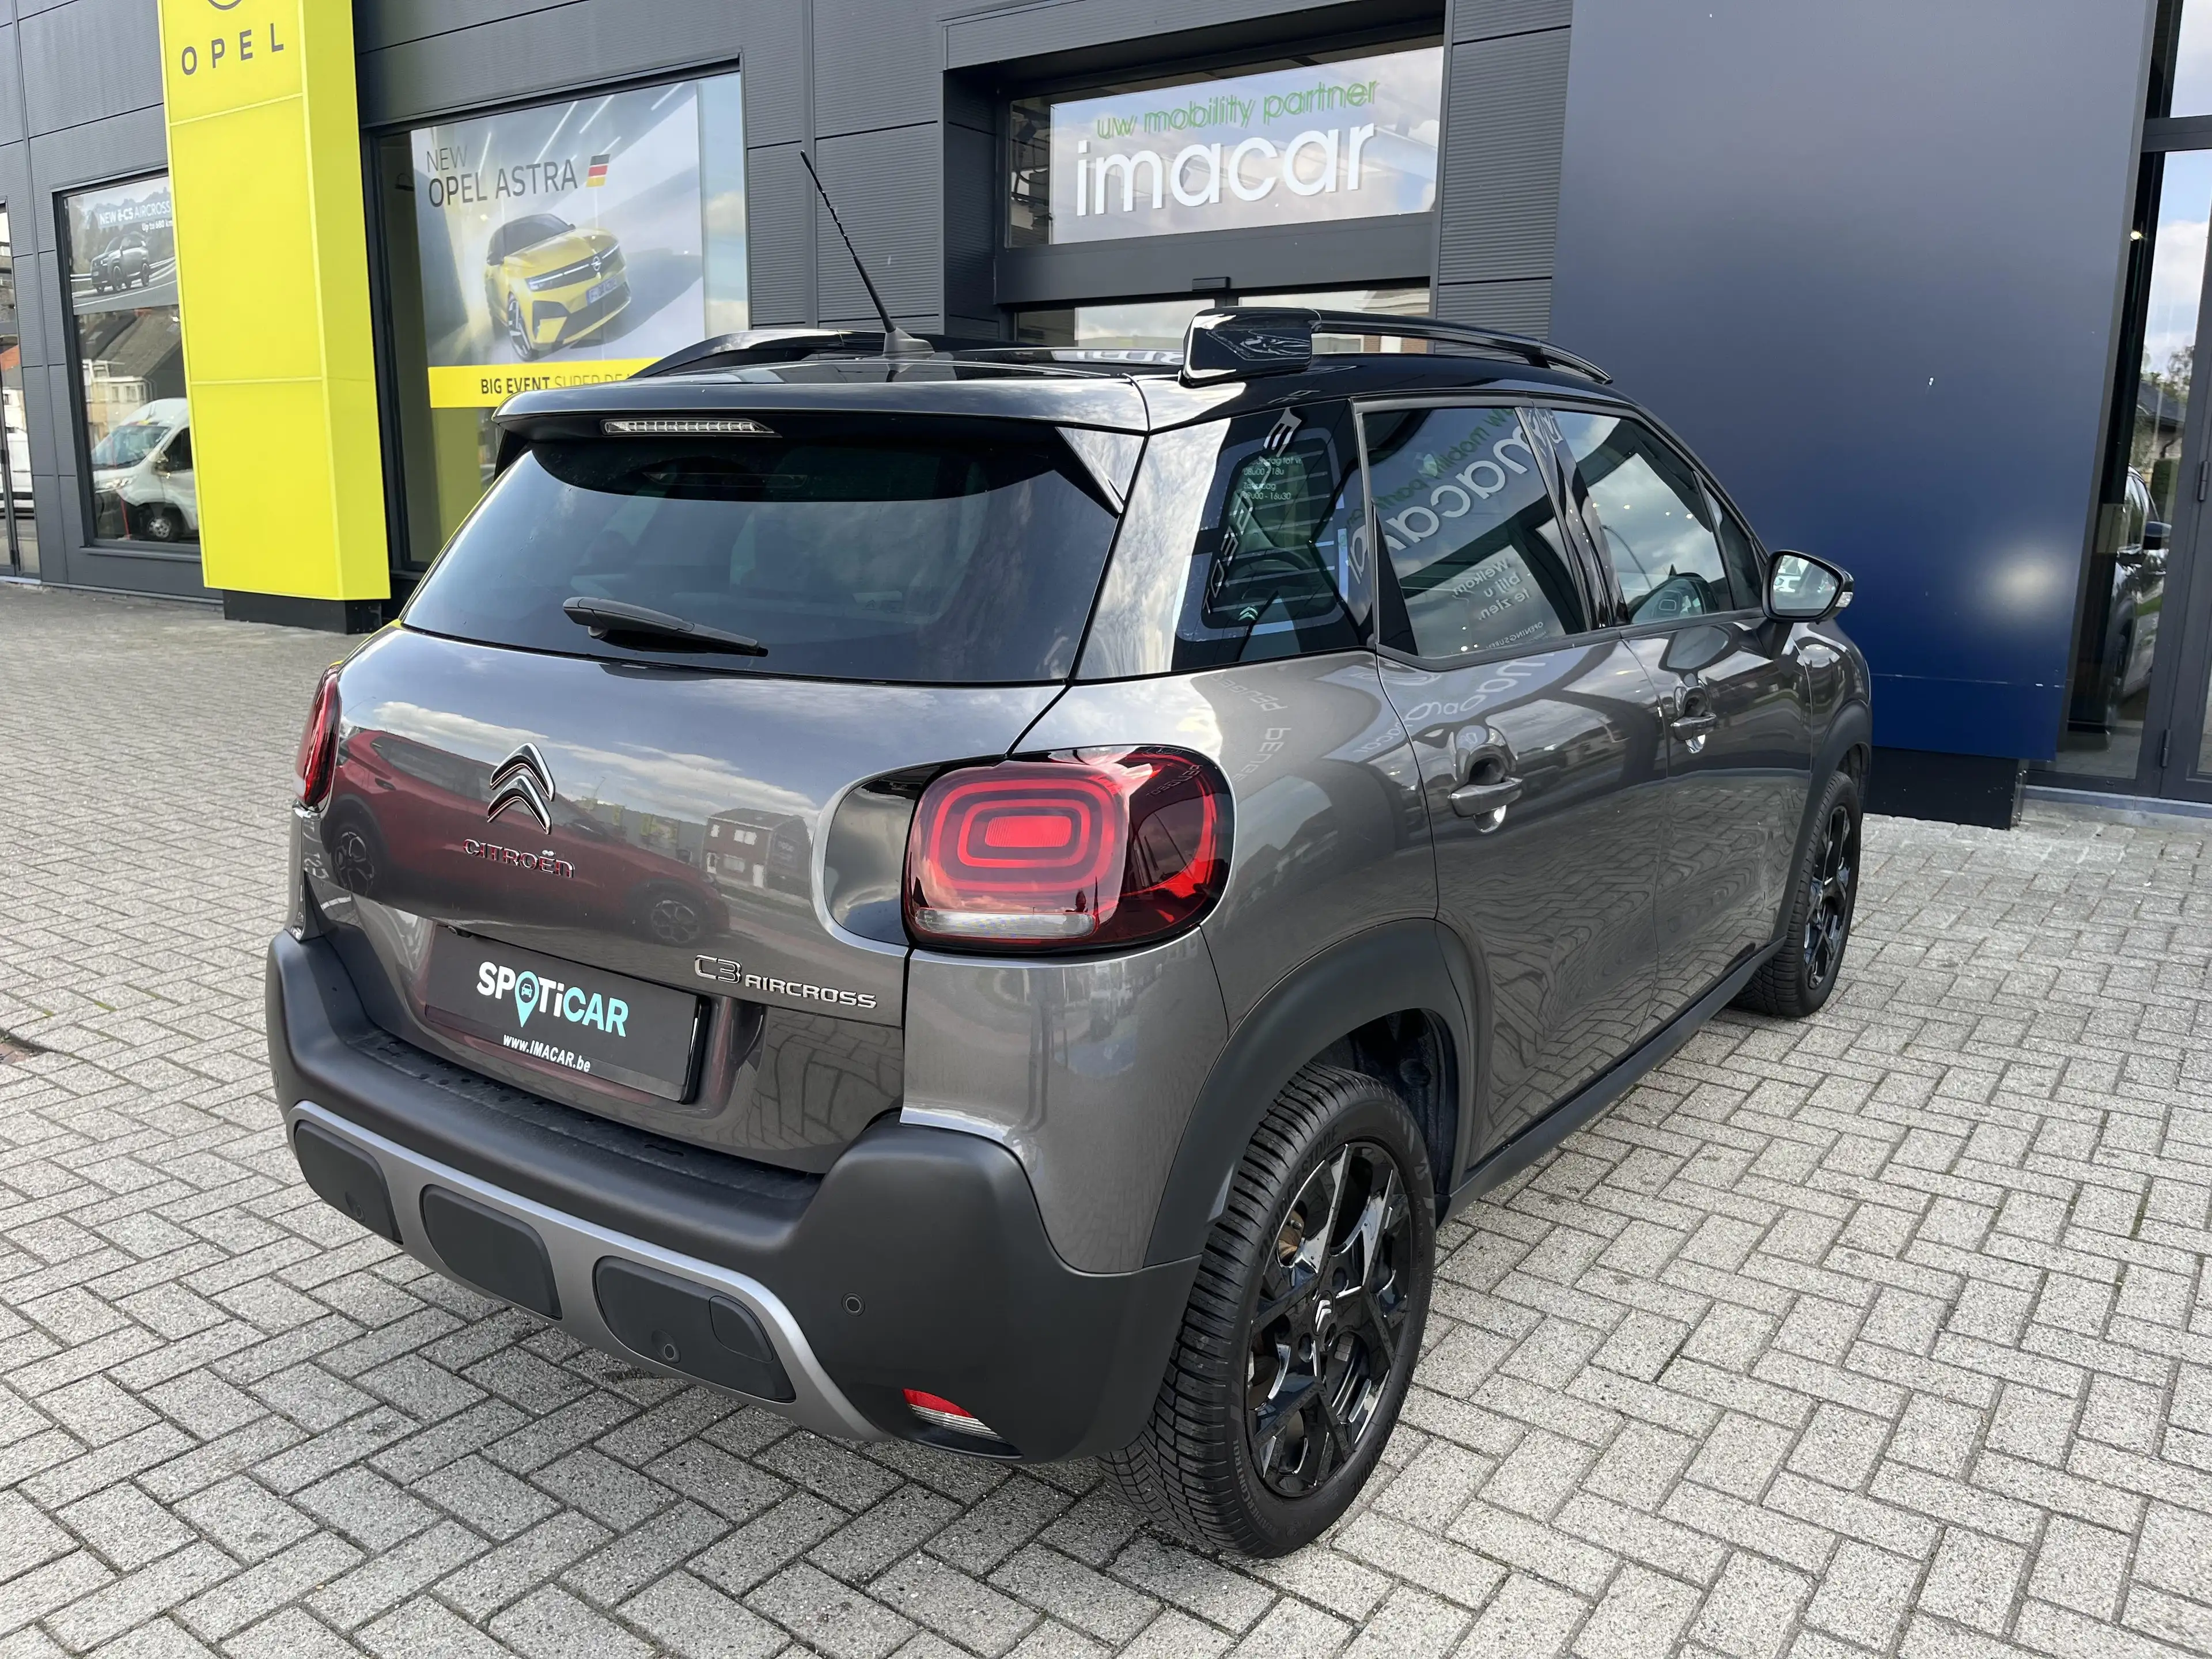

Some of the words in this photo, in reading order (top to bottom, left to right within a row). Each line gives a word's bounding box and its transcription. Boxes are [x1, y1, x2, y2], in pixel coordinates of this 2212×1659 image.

[181, 23, 284, 75] OPEL
[1096, 114, 1137, 139] uw
[1144, 94, 1256, 132] mobility
[1263, 79, 1380, 124] partner
[426, 145, 468, 173] NEW
[429, 172, 487, 207] OPEL
[495, 159, 578, 200] ASTRA
[1077, 123, 1375, 217] imacar
[99, 211, 116, 225] NEW
[134, 200, 171, 218] AIRCROSS
[481, 377, 502, 395] BIG
[506, 376, 550, 394] EVENT
[694, 953, 742, 985] C3
[745, 974, 877, 1010] AIRCROSS
[502, 1033, 591, 1073] www.IMACAR.be
